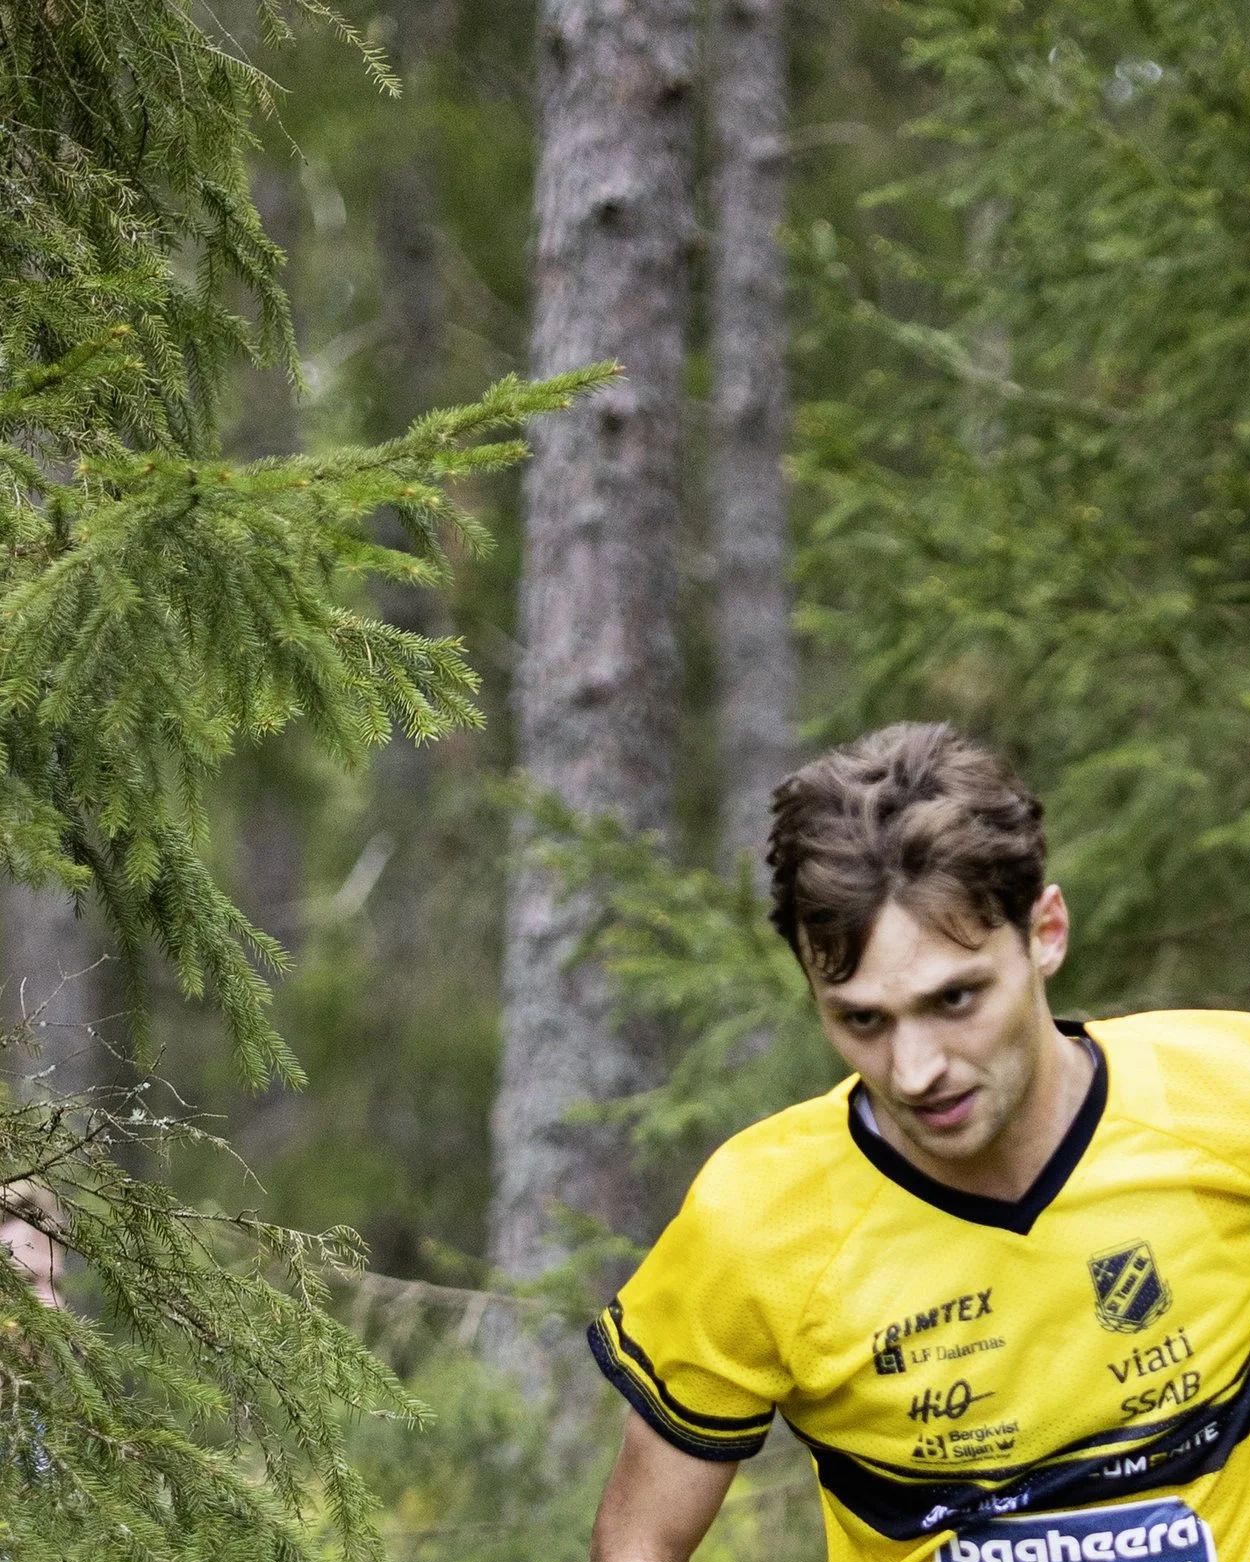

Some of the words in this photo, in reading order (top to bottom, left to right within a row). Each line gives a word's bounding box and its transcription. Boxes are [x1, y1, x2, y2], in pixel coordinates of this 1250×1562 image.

[911, 1347, 933, 1364] LF
[937, 1335, 1007, 1361] Dalarnas
[1107, 1326, 1194, 1384] viati
[1120, 1370, 1201, 1420] SSAB
[949, 1420, 1019, 1442] Bergkvist
[953, 1443, 993, 1459] Siljan
